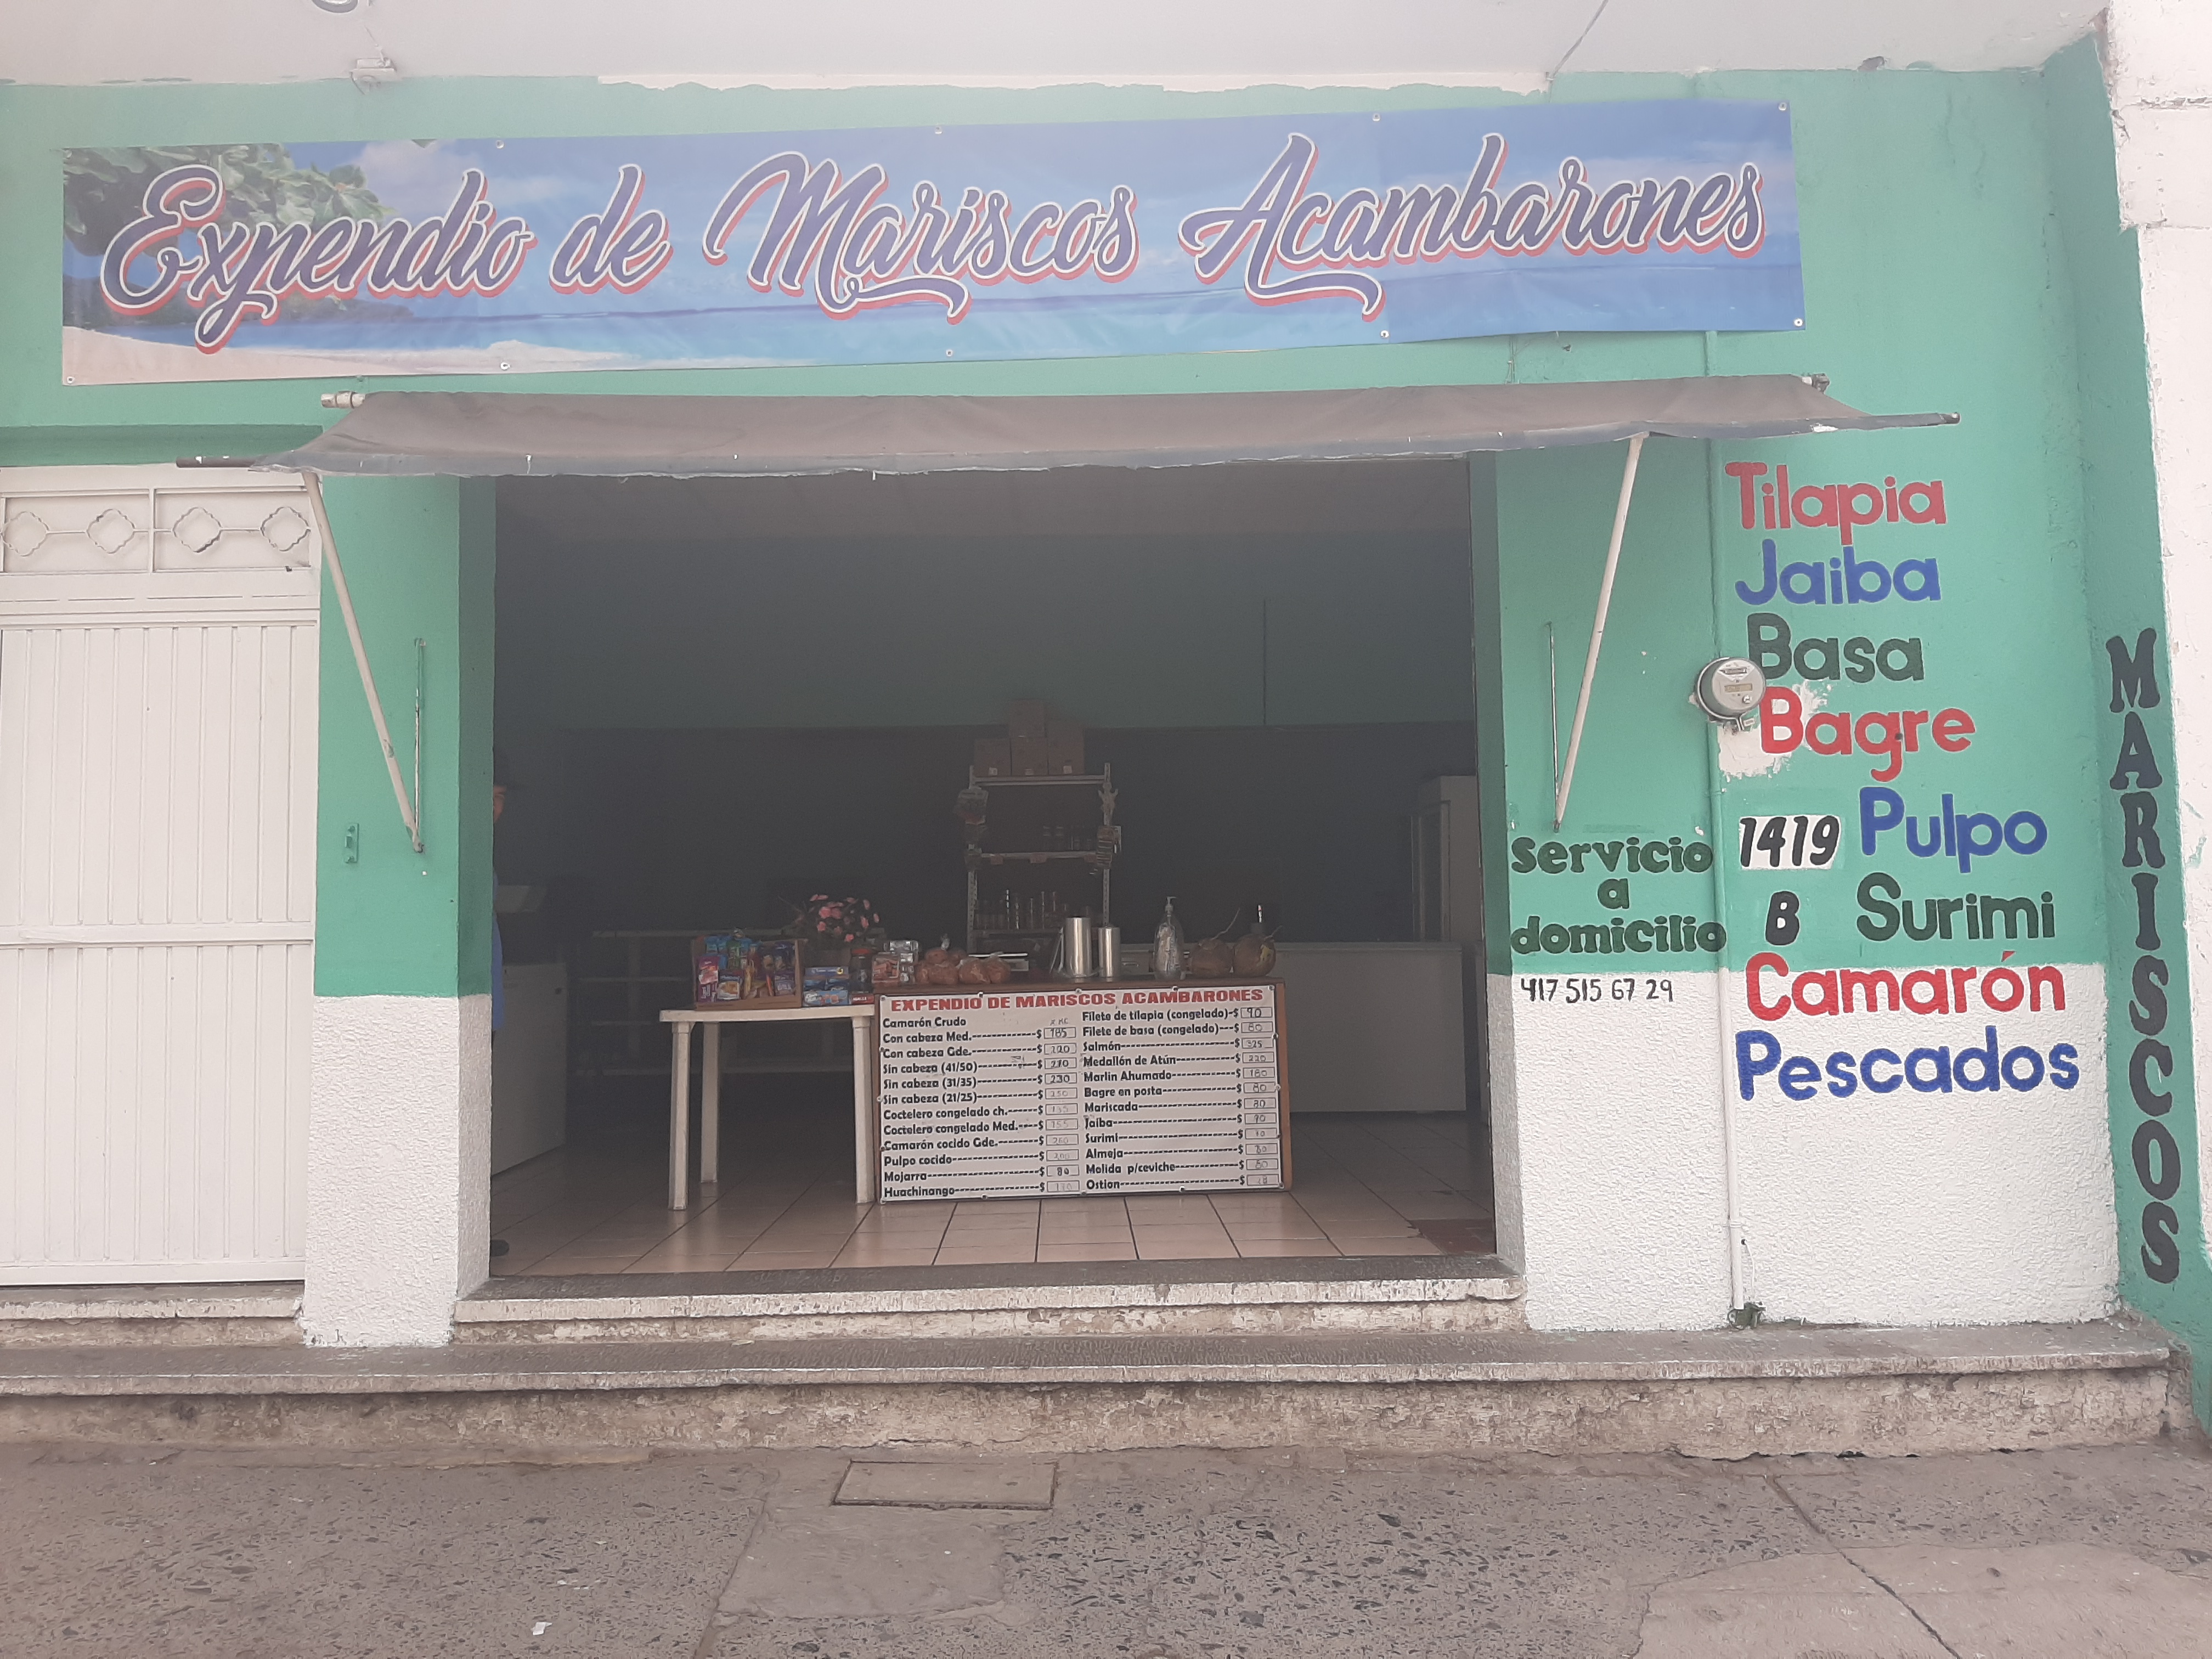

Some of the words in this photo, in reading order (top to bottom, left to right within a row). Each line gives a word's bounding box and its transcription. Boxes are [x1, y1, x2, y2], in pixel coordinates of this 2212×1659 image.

[101, 163, 538, 355] Expendio
[549, 163, 675, 296] de
[702, 150, 1139, 325] Mariscos
[1178, 132, 1765, 321] Acambarones
[1725, 462, 1947, 545] Tilapia
[1735, 539, 1941, 605] Jaiba
[1747, 612, 1925, 684] Basa
[1759, 686, 1976, 782] Bagre
[1859, 787, 2047, 875] Pulpo
[1739, 815, 1840, 867] 1419
[1597, 878, 1630, 909] a
[1857, 872, 2055, 941] Surimi
[1764, 890, 1801, 946] B
[1510, 915, 1727, 955] domicilio
[2106, 627, 2182, 1285] MARISCOS
[1521, 978, 1558, 1002] 417
[1566, 979, 1602, 1003] 515
[1610, 978, 1636, 1001] 67
[1645, 978, 1673, 1002] 29
[1745, 950, 2067, 1022] Camarón
[891, 997, 981, 1011] EXPENDIO
[988, 996, 1011, 1009] DE
[1015, 994, 1116, 1008] MARISCOS
[1122, 989, 1263, 1005] ACAMBARONES
[1114, 1009, 1127, 1020] de
[1128, 1008, 1164, 1022] tilapia
[883, 1017, 932, 1028] Camarón
[934, 1017, 967, 1027] Crudo
[883, 1034, 904, 1043] Con
[906, 1032, 944, 1043] cabeza
[946, 1031, 973, 1042] Med.
[1082, 1026, 1111, 1037] Filete
[1114, 1025, 1127, 1036] de
[1130, 1024, 1155, 1035] basa
[883, 1048, 904, 1059] Con
[906, 1046, 944, 1058] cabeza
[1083, 1040, 1121, 1052] Salmón
[883, 1063, 899, 1074] Sin
[900, 1062, 938, 1074] cabeza
[941, 1060, 978, 1074] (41/50)
[1083, 1055, 1132, 1067] Medallón
[1135, 1054, 1148, 1065] de
[1150, 1053, 1177, 1064] Atún
[1735, 1025, 2080, 1101] Pescados
[883, 1079, 900, 1090] Sin
[901, 1077, 939, 1089] cabeza
[942, 1076, 978, 1090] (31/35)
[1084, 1070, 1118, 1082] Marlin
[1121, 1070, 1172, 1081] Ahumado
[883, 1094, 899, 1104] Sin
[901, 1093, 939, 1103] cabeza
[942, 1091, 978, 1105] (21/25)
[1084, 1087, 1115, 1099] Bagre
[1133, 1087, 1163, 1097] posta
[884, 1109, 933, 1120] Coctelero
[935, 1106, 990, 1119] congelado
[1085, 1101, 1138, 1113] Mariscada
[935, 1121, 990, 1135] congelado
[1085, 1117, 1114, 1130] Jaiba
[884, 1139, 934, 1152] Camarón
[936, 1137, 970, 1149] cocido
[1086, 1132, 1119, 1143] Surimi
[884, 1155, 916, 1167] Pulpo
[919, 1153, 953, 1165] cocido
[1086, 1148, 1124, 1159] Almeja
[1086, 1163, 1121, 1174] Molida
[1127, 1161, 1176, 1175] p/ceviche
[884, 1172, 928, 1183] Mojarra
[1086, 1178, 1120, 1190] Ostion
[884, 1186, 956, 1199] Huachinango
